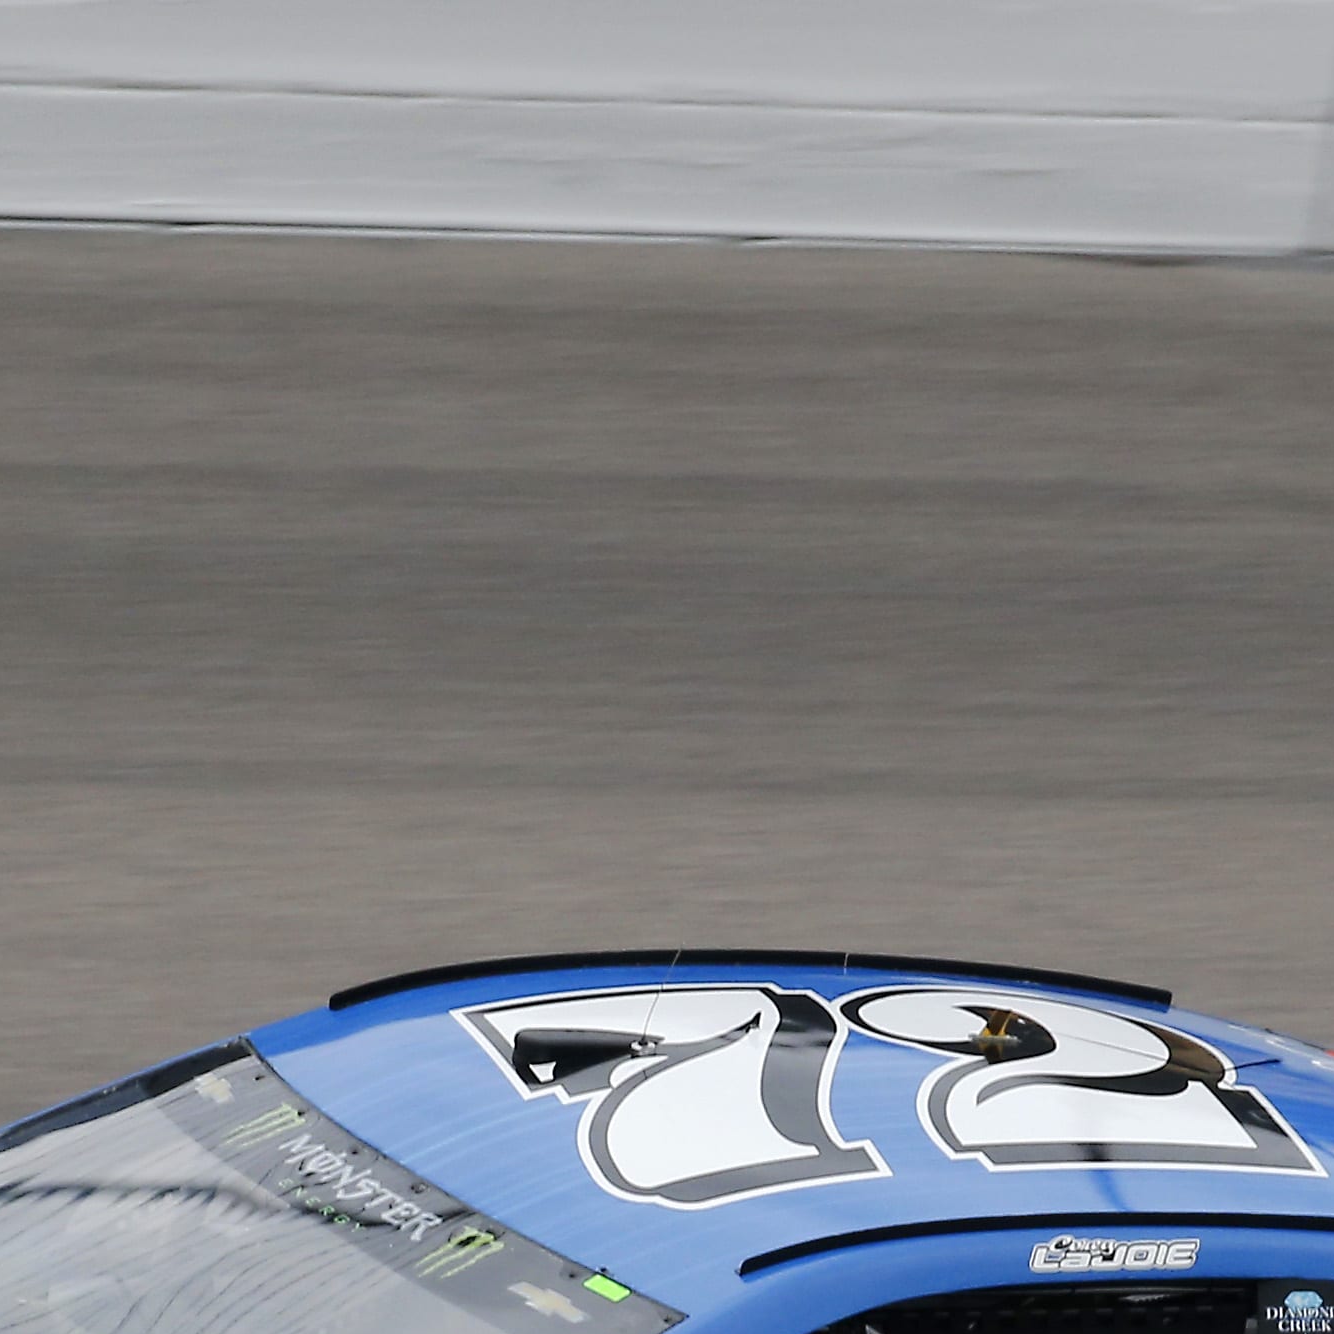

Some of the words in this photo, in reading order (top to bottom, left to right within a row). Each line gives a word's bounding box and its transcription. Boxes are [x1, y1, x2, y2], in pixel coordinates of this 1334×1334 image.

[449, 980, 1329, 1210] 72
[278, 1133, 444, 1242] MONSTER
[1278, 1319, 1332, 1332] CREEK
